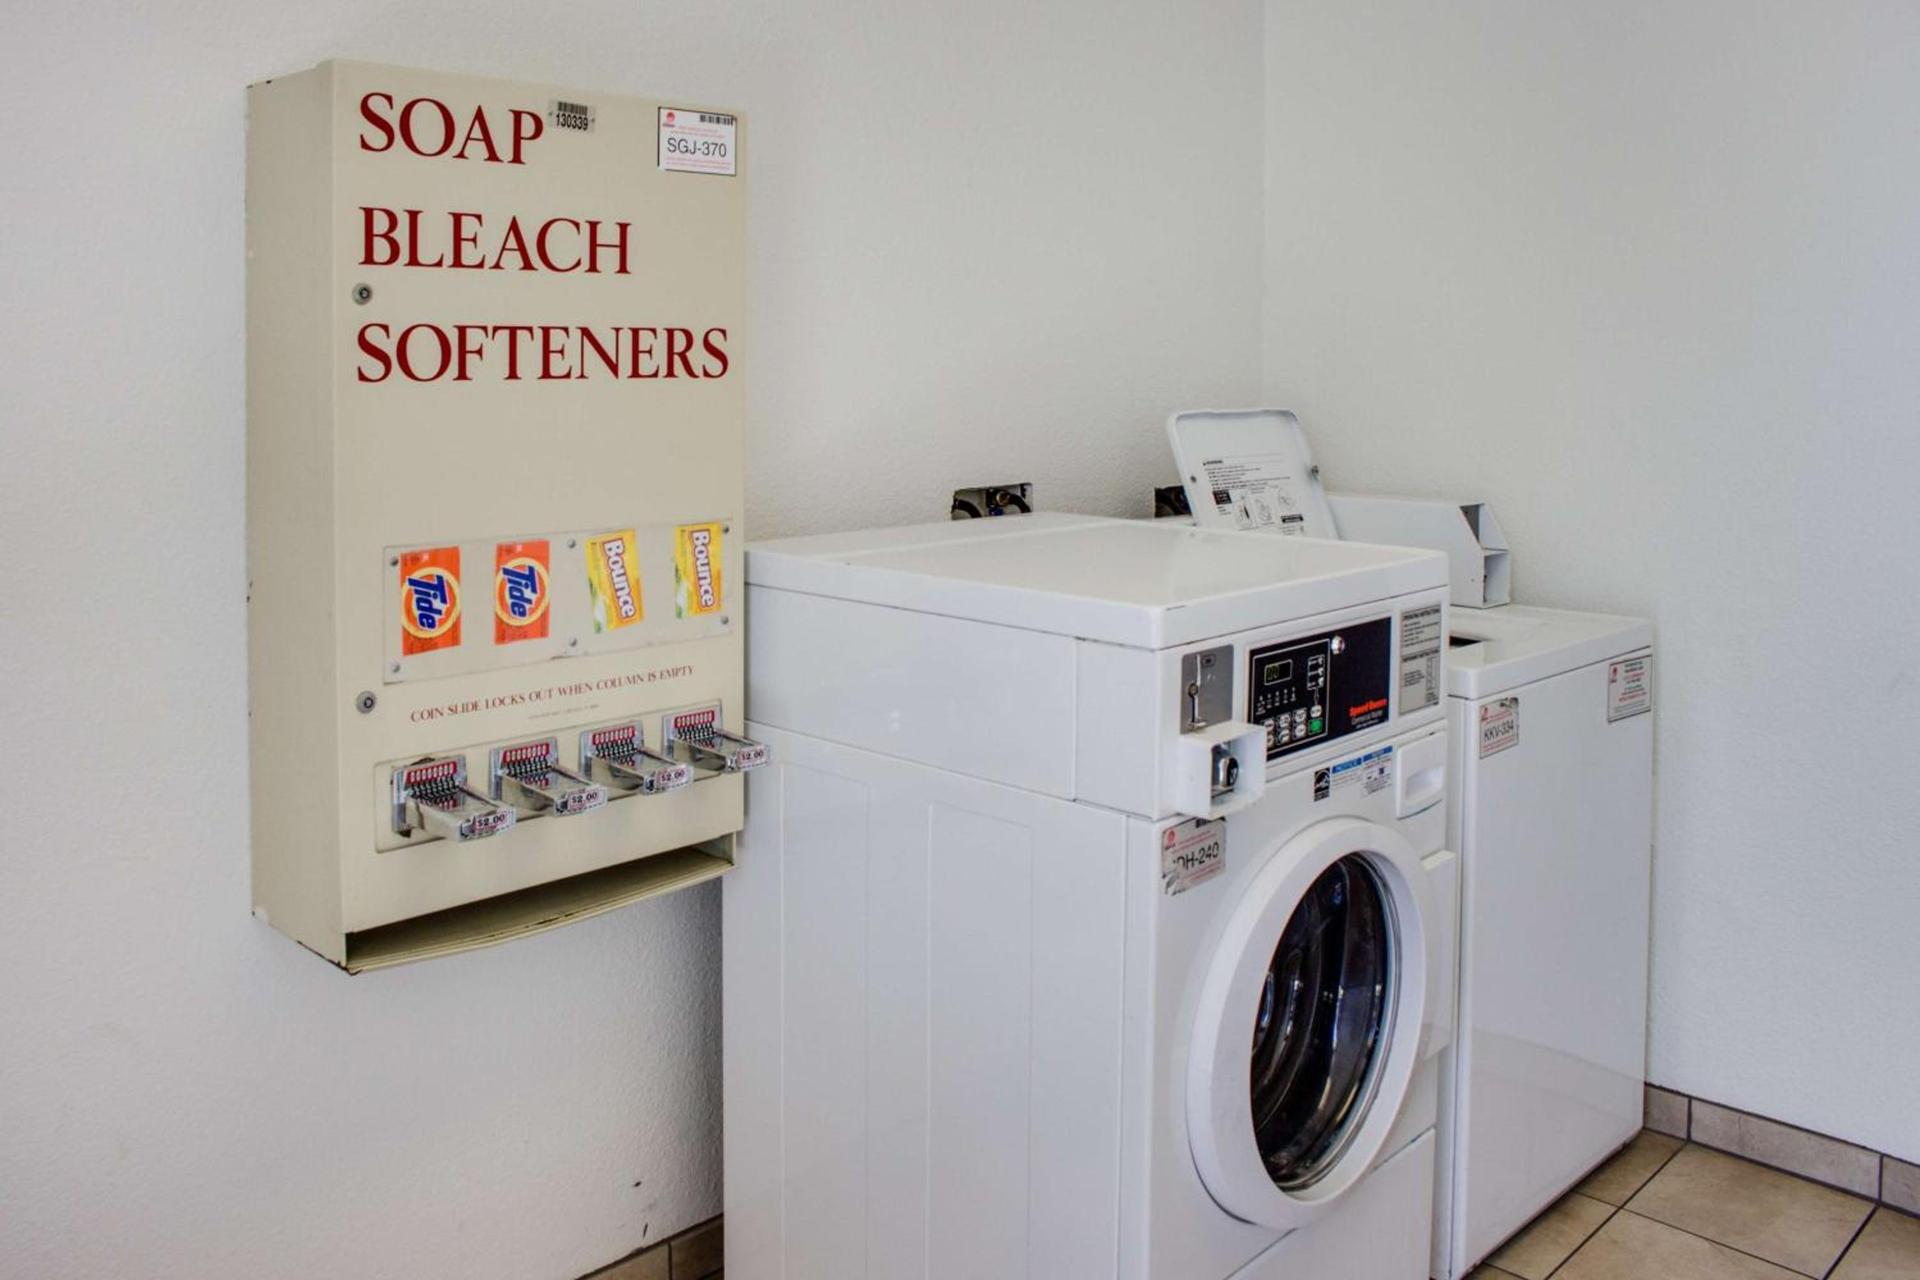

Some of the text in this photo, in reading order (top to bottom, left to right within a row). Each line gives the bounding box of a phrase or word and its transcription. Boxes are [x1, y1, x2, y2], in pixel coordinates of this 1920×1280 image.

[360, 92, 545, 165] SOAP
[556, 113, 589, 131] 130339
[666, 137, 728, 158] SGJ-370
[358, 206, 632, 275] BLEACH
[357, 322, 729, 383] SOFTENERS
[502, 564, 538, 618] Tide
[602, 539, 636, 619] Bounce
[690, 528, 715, 608] Bounce
[407, 574, 448, 630] Tide
[410, 665, 695, 722] COIN SLIDE LOCKS OUT WHEN COLUMN IS EMPTY
[571, 791, 598, 804] $2.00
[661, 769, 686, 782] $2.00
[477, 812, 506, 827] $2.00
